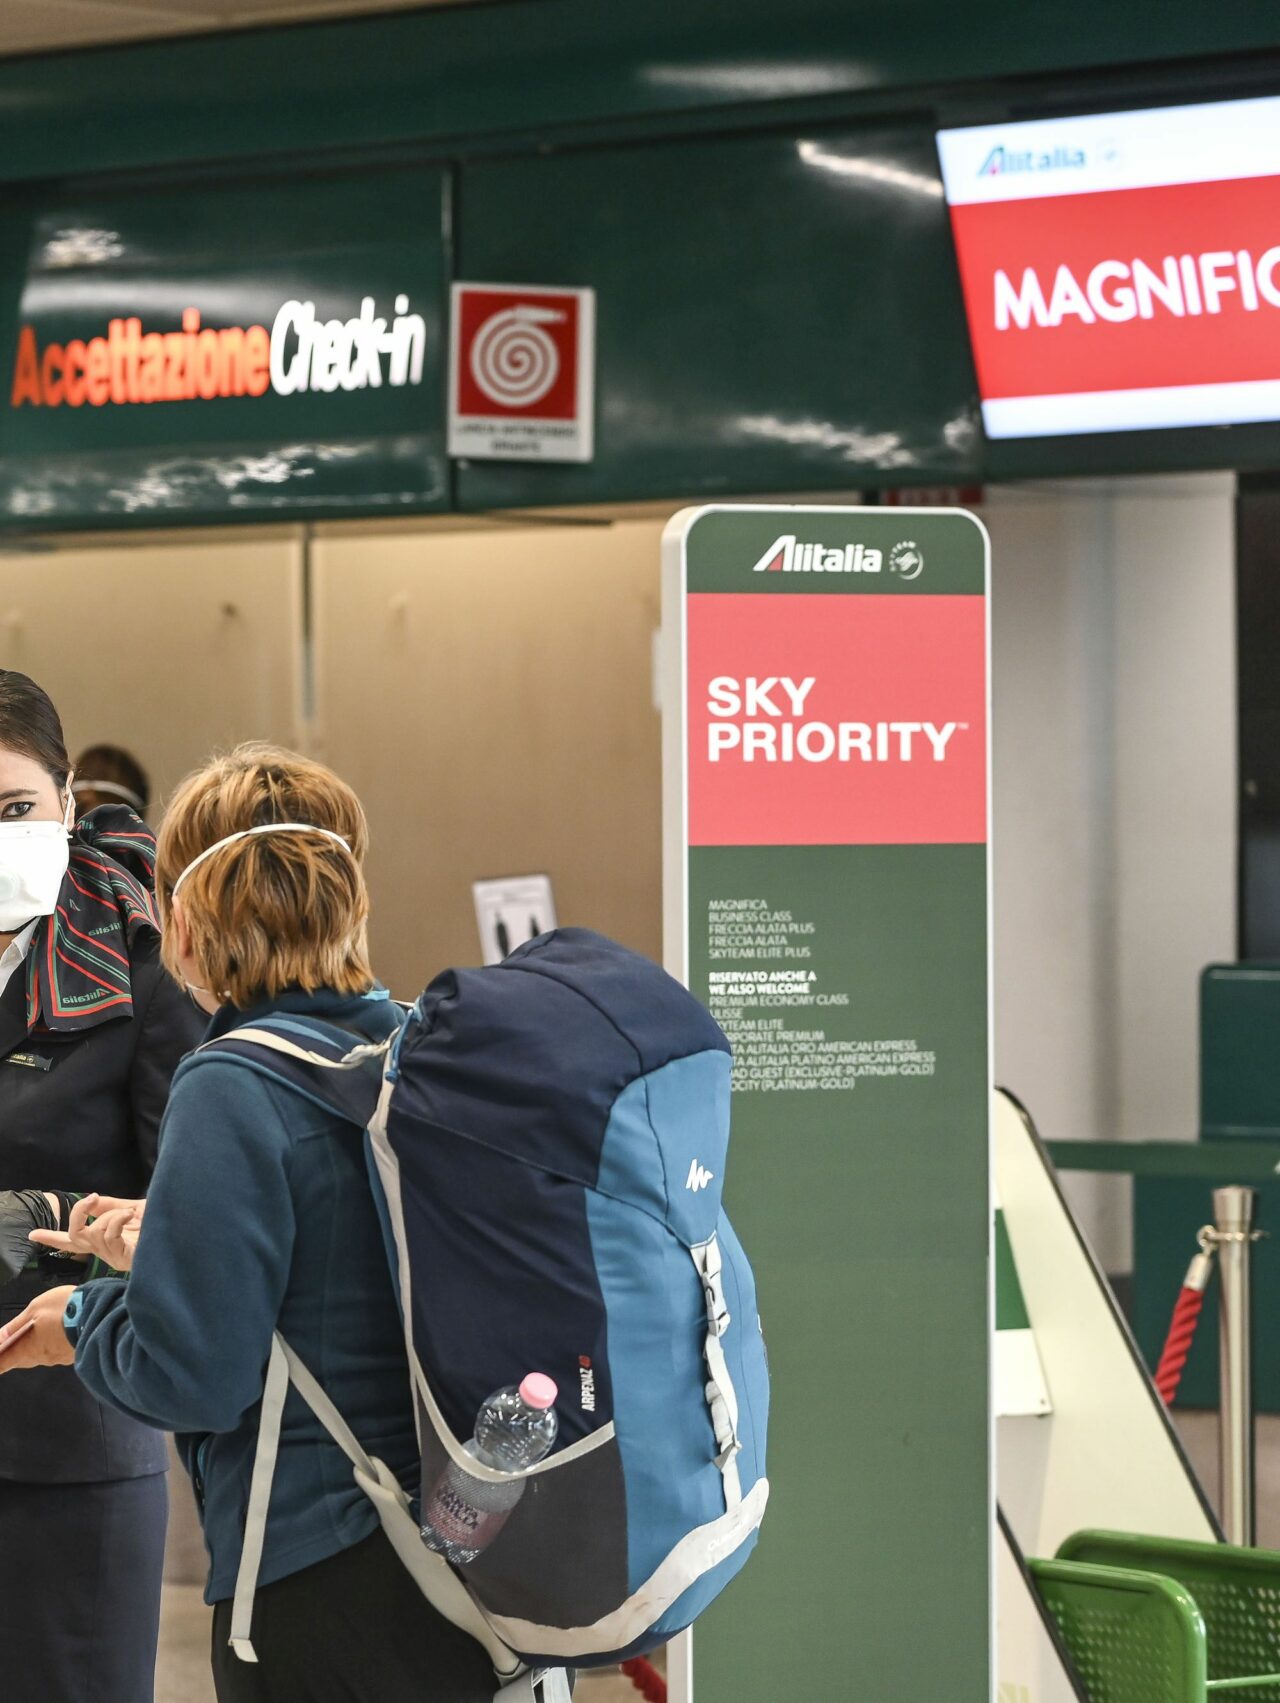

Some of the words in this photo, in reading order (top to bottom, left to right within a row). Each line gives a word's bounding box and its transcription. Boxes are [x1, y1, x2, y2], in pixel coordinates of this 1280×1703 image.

[977, 146, 1085, 177] Alitalia
[11, 306, 270, 407] Accettazione
[269, 293, 426, 396] Check-in
[753, 534, 883, 572] Alitalia
[706, 675, 817, 718] SKY
[707, 721, 958, 763] PRIORITY
[708, 899, 768, 911] MAGNIFICA
[709, 911, 758, 923] BUSINESS
[759, 911, 793, 922] CLASS
[708, 923, 754, 935] FRECCIA
[754, 923, 788, 934] ALATA
[789, 922, 816, 934] PLUS
[708, 935, 754, 947] FRECCIA
[754, 935, 788, 946] ALATA
[708, 947, 755, 959] SKYTEAM
[756, 947, 783, 958] ELITE
[785, 946, 811, 958] PLUS
[708, 971, 768, 983] RISERVATO
[769, 970, 807, 982] ANCHE
[808, 970, 817, 982] A
[708, 984, 726, 995] WE
[727, 983, 755, 995] ALSO
[756, 983, 810, 994] WELCOME
[708, 995, 758, 1007] PREMIUM
[759, 995, 815, 1007] ECONOMY
[816, 993, 849, 1005] CLASS
[718, 1019, 757, 1031] YTEAM
[758, 1018, 785, 1031] ELITE
[725, 1031, 775, 1043] RPORATE
[775, 1030, 826, 1042] PREMIUM
[746, 1043, 789, 1055] ALITALIA
[790, 1042, 816, 1054] ORO
[818, 1041, 872, 1053] AMERICAN
[873, 1040, 917, 1052] EXPRESS
[746, 1055, 789, 1067] ALITALIA
[790, 1054, 835, 1066] PLATINO
[837, 1053, 891, 1065] AMERICAN
[892, 1051, 936, 1063] EXPRESS
[749, 1067, 782, 1079] GUEST
[731, 1080, 760, 1092] OCITY
[580, 1367, 595, 1411] ARPENAZ
